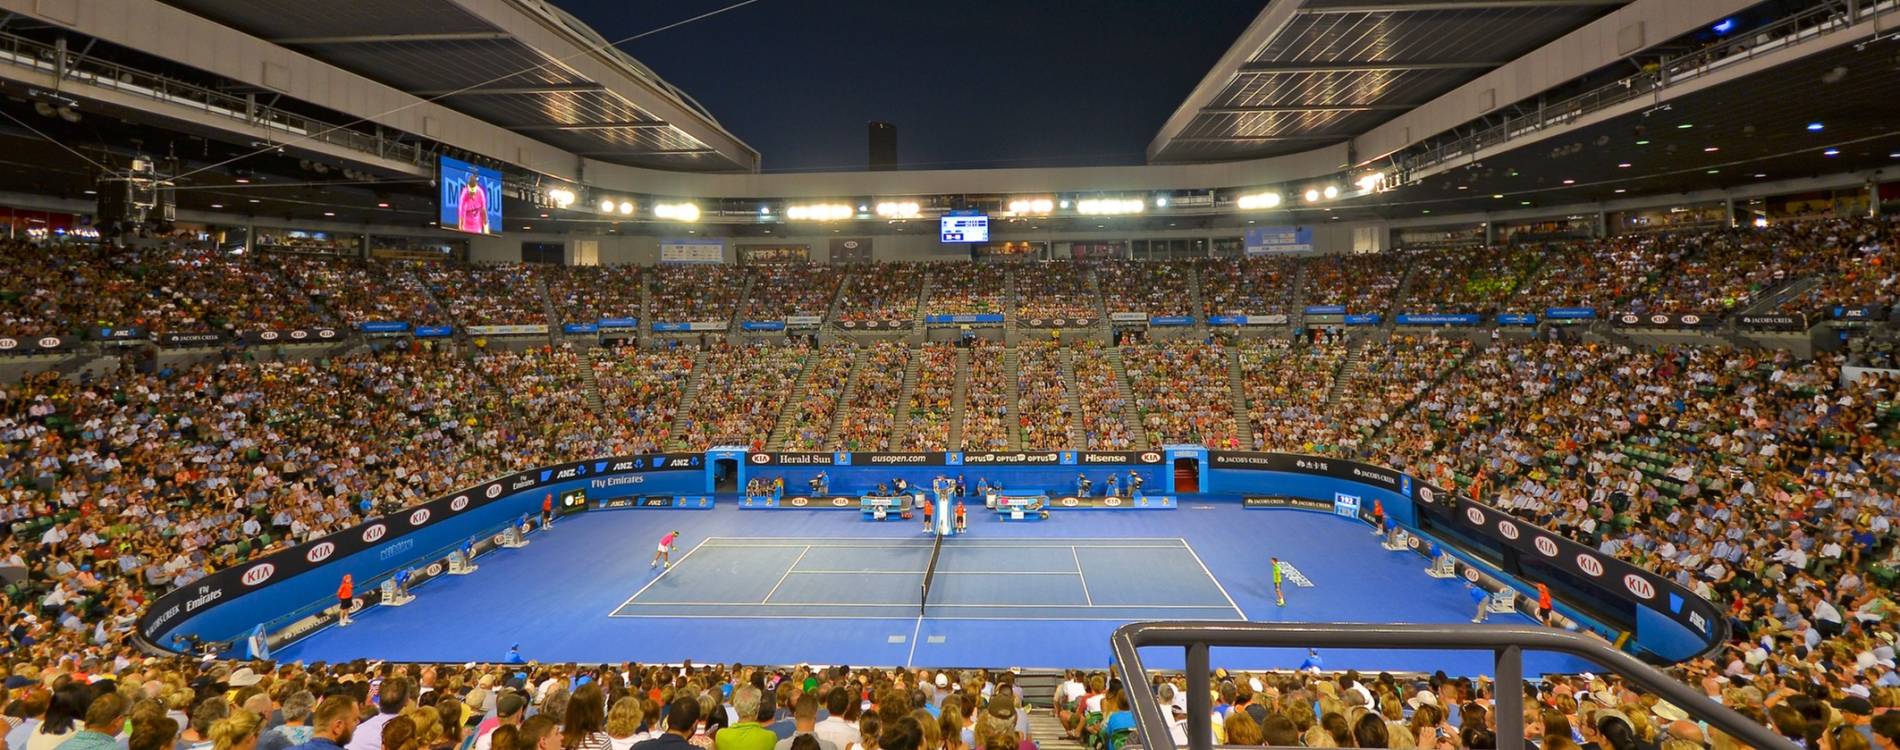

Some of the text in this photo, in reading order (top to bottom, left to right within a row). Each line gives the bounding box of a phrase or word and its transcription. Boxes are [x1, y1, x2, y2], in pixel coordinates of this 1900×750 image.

[671, 459, 689, 467] ANZ
[780, 455, 831, 464] Herald Sun
[872, 455, 926, 464] ausopen.com
[1085, 454, 1127, 463] Hisense
[1143, 453, 1158, 461] KIA
[613, 462, 632, 470] ANZ
[557, 468, 576, 479] ANZ
[592, 475, 644, 488] Fly Emirates
[488, 485, 501, 497] KIA
[453, 497, 467, 510] KIA
[413, 511, 429, 523] KIA
[1469, 509, 1484, 523] KIA
[366, 526, 383, 541] KIA
[1501, 523, 1518, 538] KIA
[311, 546, 331, 560] KIA
[1537, 537, 1556, 556] KIA
[1580, 556, 1601, 575] KIA
[247, 566, 270, 582] KIA
[1628, 577, 1652, 597] KIA
[186, 588, 222, 612] Emirates
